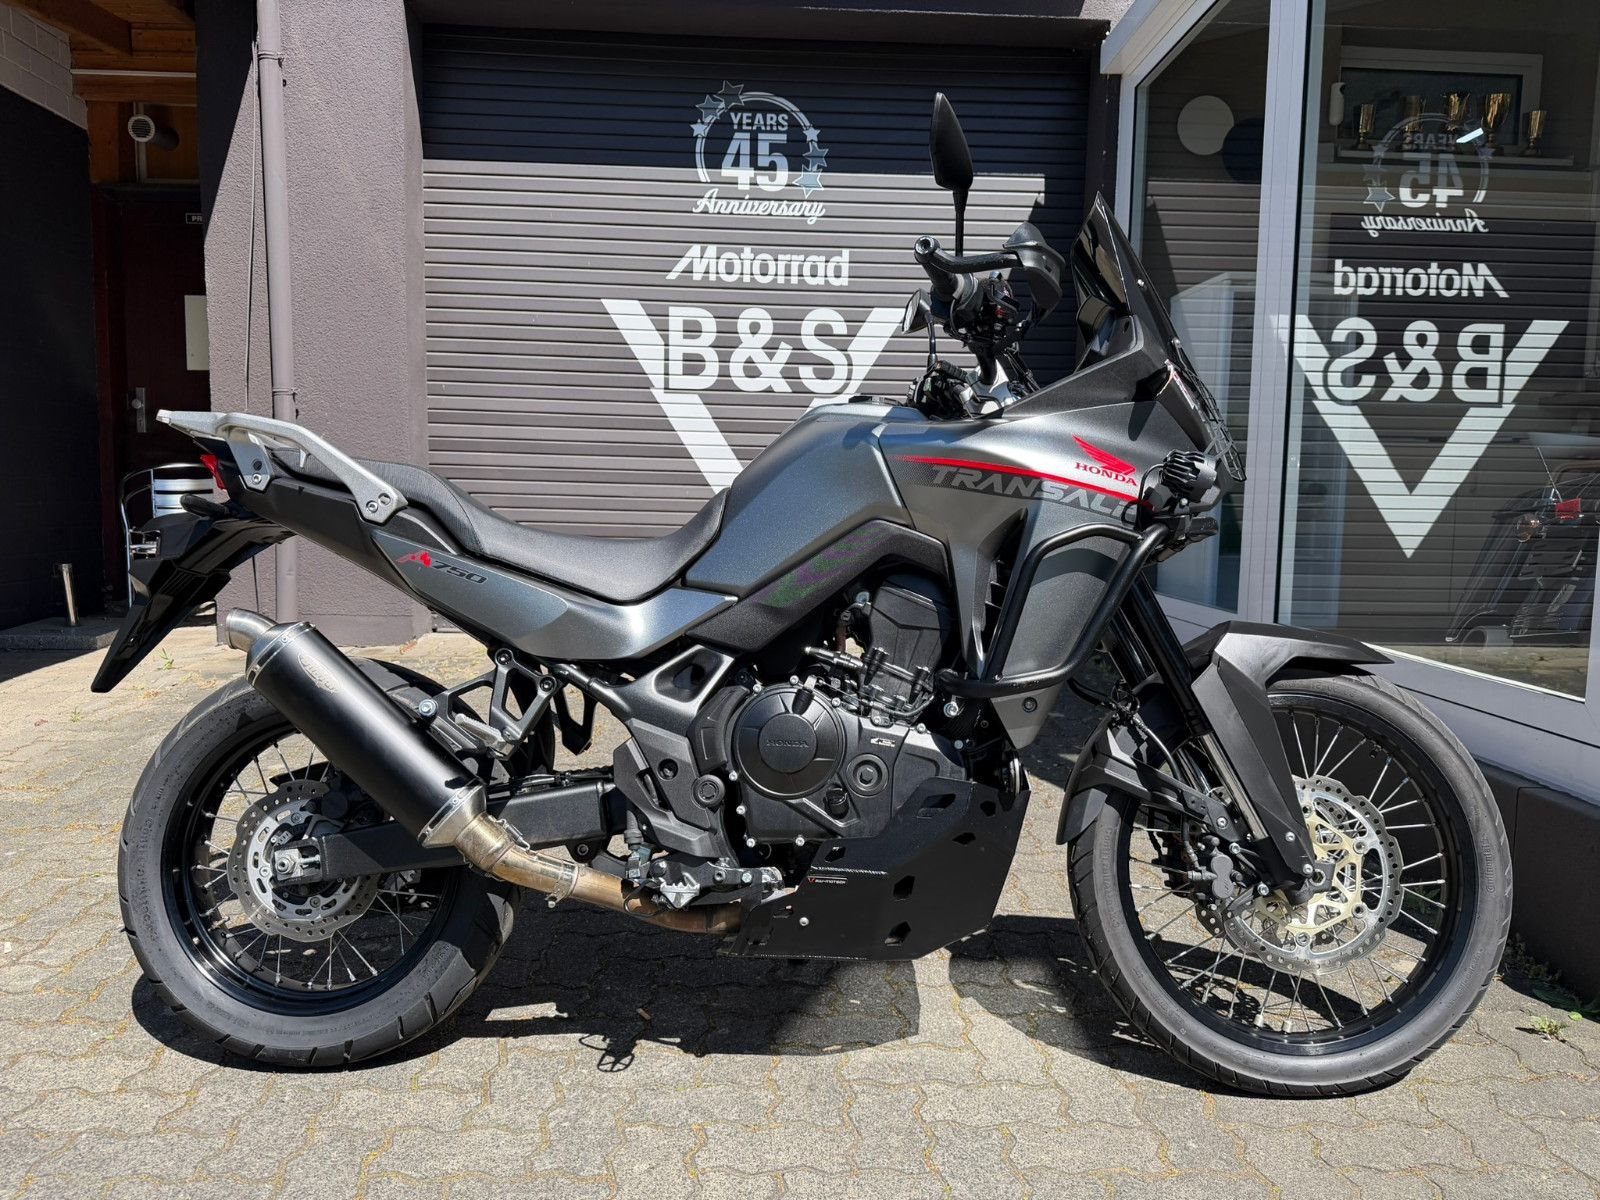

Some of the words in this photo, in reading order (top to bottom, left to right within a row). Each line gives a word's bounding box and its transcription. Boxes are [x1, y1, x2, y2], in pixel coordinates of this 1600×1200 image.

[730, 112, 789, 131] YEARS
[721, 132, 789, 191] 45
[692, 188, 826, 225] Anniversary
[665, 244, 849, 286] Motorrad
[668, 306, 849, 394] B&S
[1075, 461, 1138, 487] HONDA
[432, 560, 488, 584] 750
[766, 739, 809, 748] HONDA
